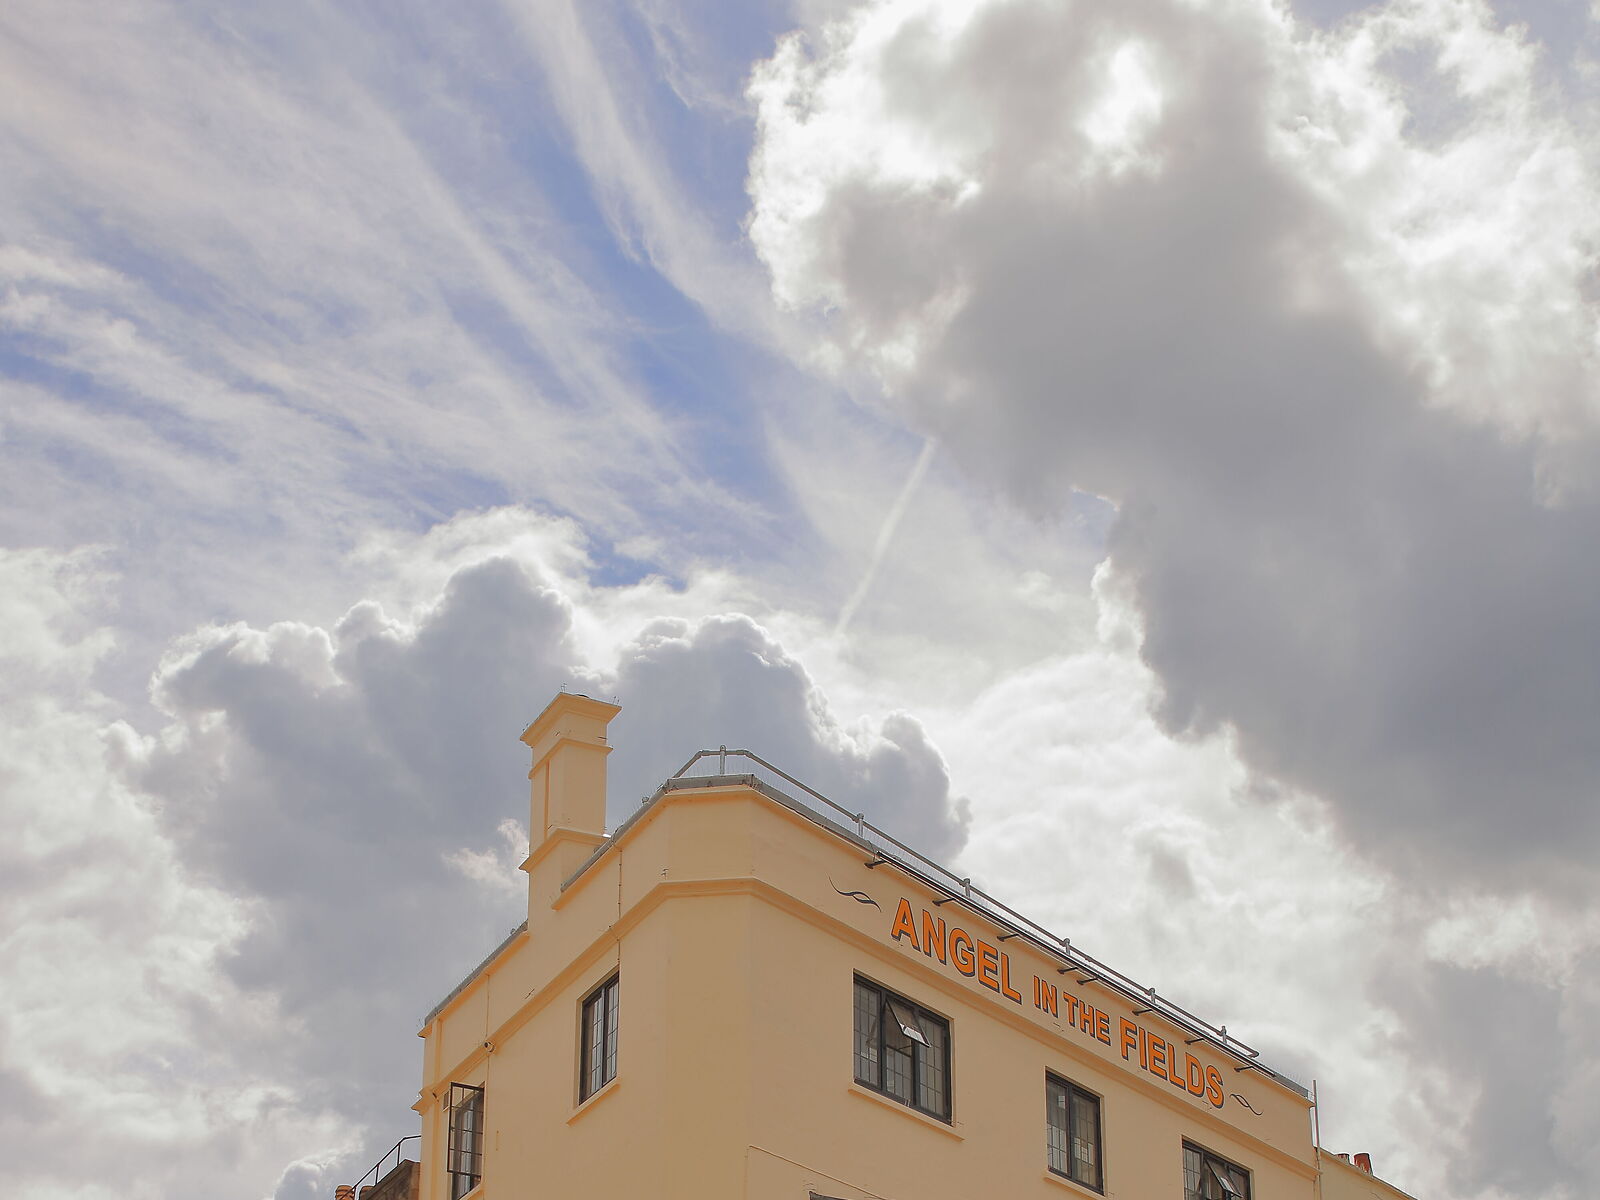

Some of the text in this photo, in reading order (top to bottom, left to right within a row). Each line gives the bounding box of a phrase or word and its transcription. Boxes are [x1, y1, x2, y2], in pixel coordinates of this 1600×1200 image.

[891, 897, 1225, 1108] ANGEL IN THE FIELDS
